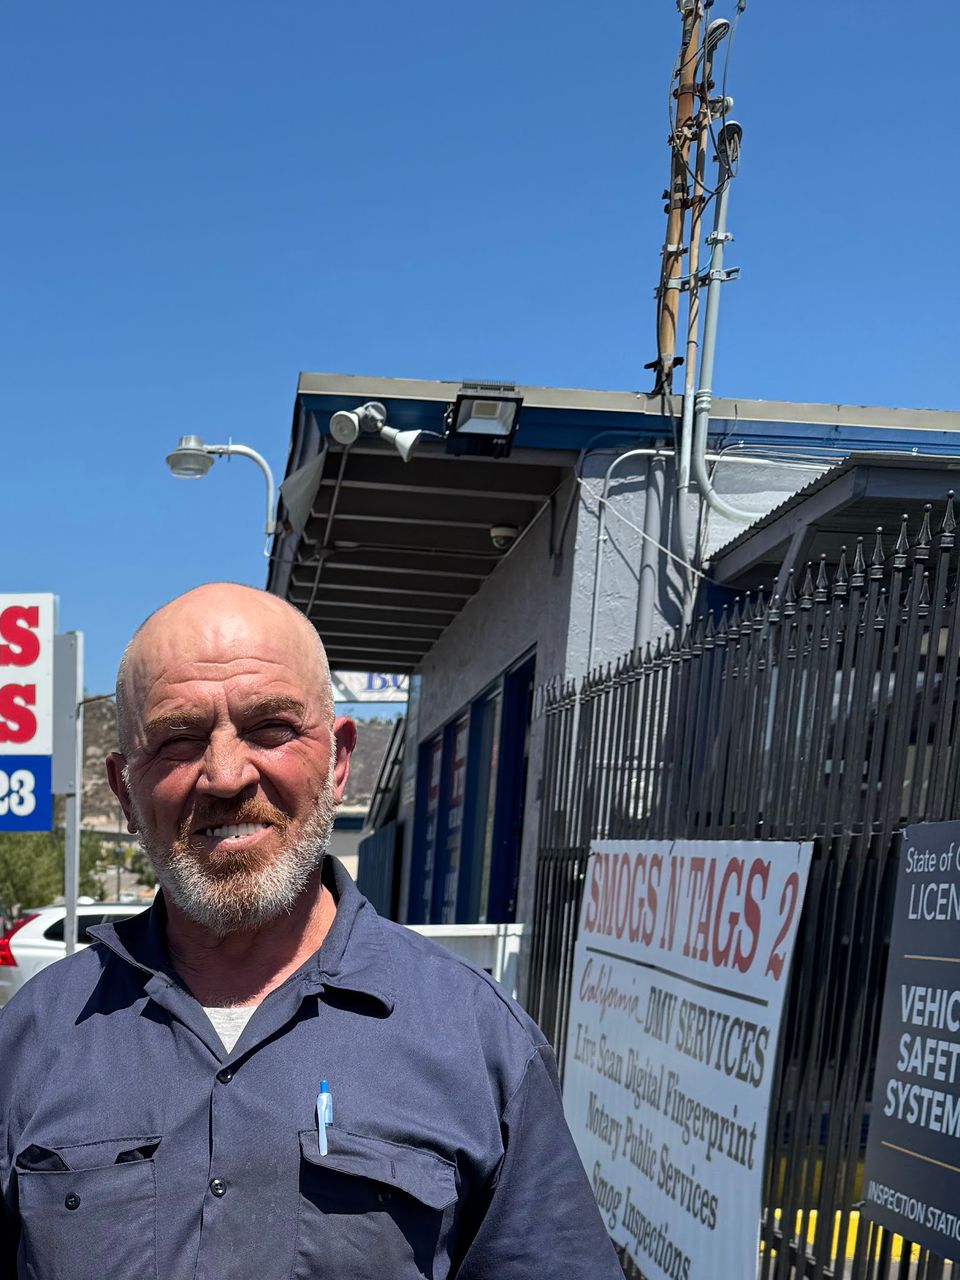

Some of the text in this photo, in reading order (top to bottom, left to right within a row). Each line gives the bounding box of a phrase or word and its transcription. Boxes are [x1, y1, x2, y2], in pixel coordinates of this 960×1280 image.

[584, 851, 801, 982] SMOGS N TAGS 2
[905, 846, 937, 873] State
[939, 842, 955, 872] of
[578, 958, 771, 1089] California DMV SERVICES
[573, 1022, 758, 1171] Live Scan Digital Fingerprint
[585, 1091, 720, 1231] Notary Public Services
[591, 1160, 623, 1231] Smog
[868, 1180, 926, 1224] INSPECTION
